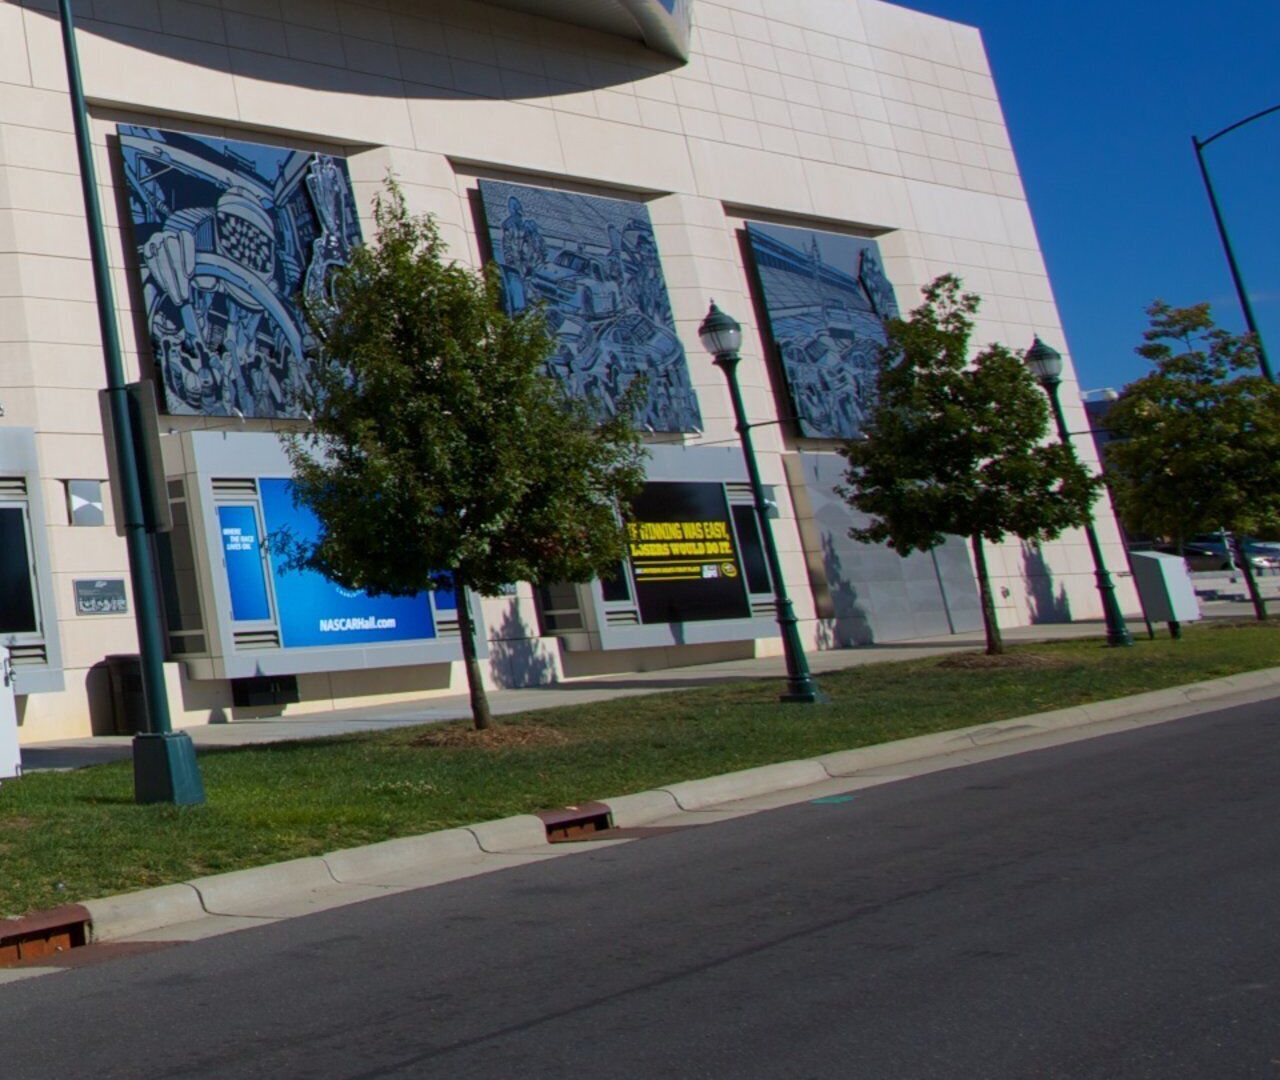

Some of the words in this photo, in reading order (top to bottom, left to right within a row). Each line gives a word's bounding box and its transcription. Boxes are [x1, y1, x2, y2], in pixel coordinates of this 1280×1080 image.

[639, 522, 683, 540] WINNING
[681, 522, 704, 539] WAS
[630, 543, 671, 557] LOSERS
[670, 542, 705, 555] WOULD
[705, 541, 719, 554] DO
[320, 617, 396, 632] NASCARHall.com
